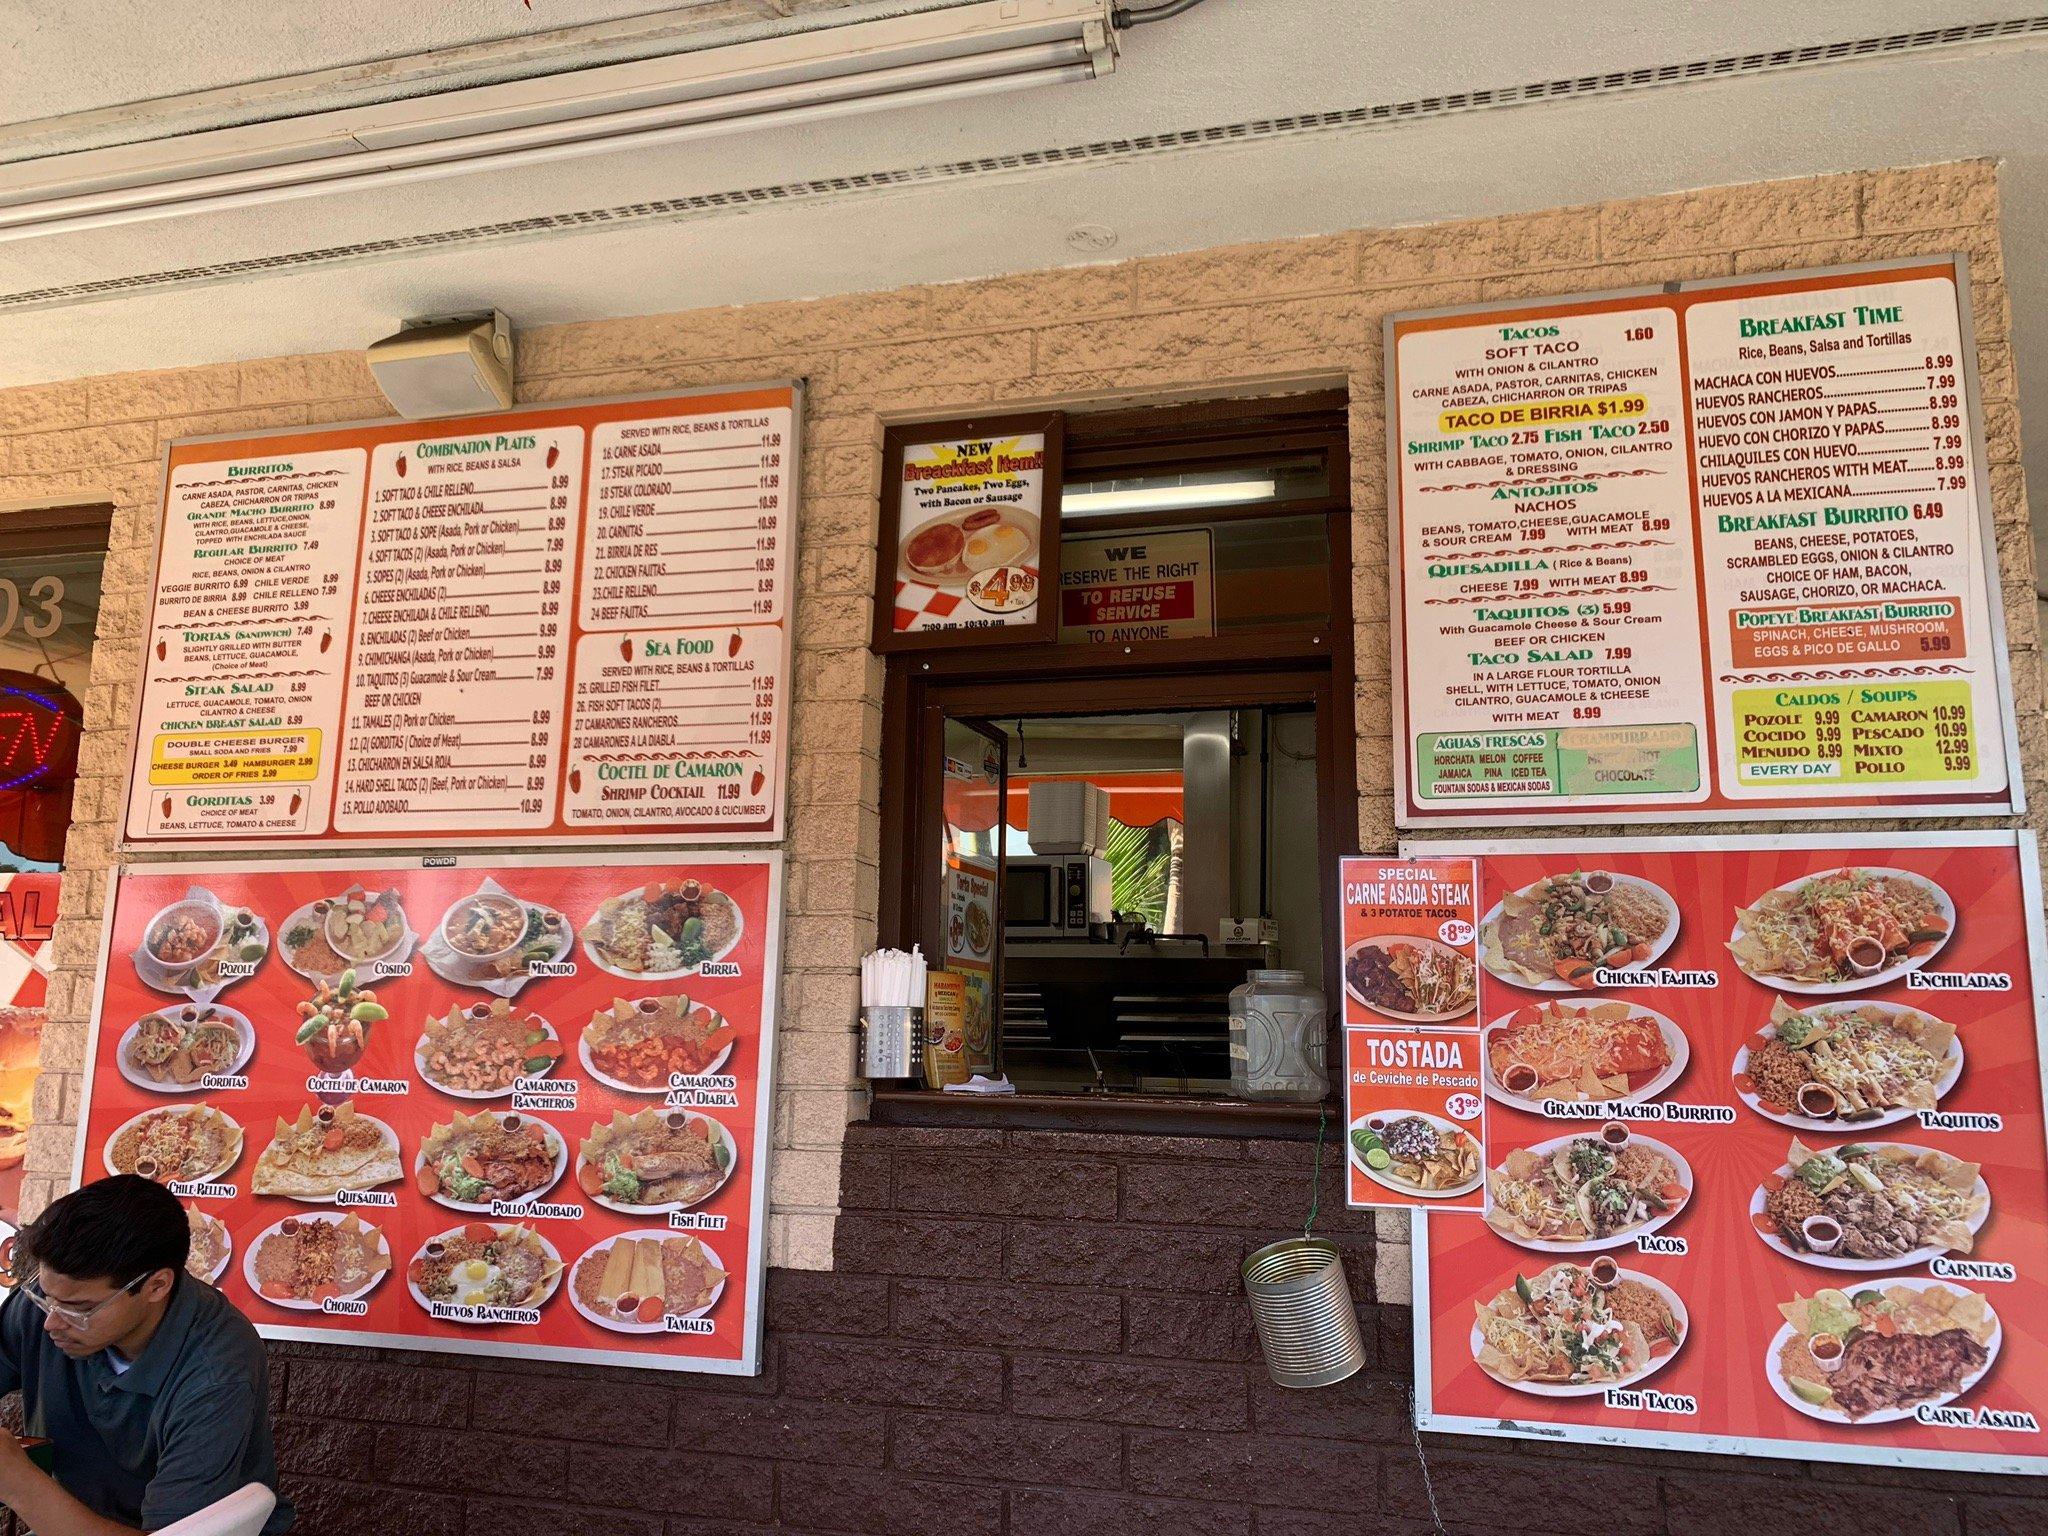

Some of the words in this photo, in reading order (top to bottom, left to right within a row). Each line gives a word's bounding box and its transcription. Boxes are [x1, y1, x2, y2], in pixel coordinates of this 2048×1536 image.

[1739, 311, 1846, 338] BREAKFAST
[1853, 306, 1903, 326] TIME
[1499, 326, 1559, 342] TACOS
[1624, 327, 1653, 342] 1.60
[1485, 346, 1527, 360] SOFT
[1534, 341, 1580, 355] TACO
[1695, 373, 1753, 391] MACHACA
[1756, 371, 1782, 385] CON
[1925, 355, 1953, 369] 8.99
[1696, 394, 1745, 410] HUEVOS
[1927, 374, 1955, 389] 7.99
[1445, 413, 1495, 429] TACO
[1500, 410, 1524, 423] DE
[1530, 405, 1593, 421] BIRRIA
[1598, 399, 1644, 415] $1.99
[1408, 439, 1465, 455] SHRIMP
[1470, 435, 1508, 449] TACO
[1511, 431, 1539, 445] 2.75
[1544, 429, 1582, 444] FISH
[1589, 424, 1636, 439] TACO
[1638, 420, 1670, 435] 2.50
[417, 440, 491, 459] COMBINATION
[495, 436, 535, 451] PLATES
[957, 442, 993, 457] NEW
[227, 463, 293, 476] BURRITOS
[904, 458, 993, 481] Breackfast
[914, 488, 934, 496] Two
[936, 483, 980, 493] Pancakes,
[983, 481, 1003, 489] Two
[1006, 479, 1029, 489] Eggs,
[1490, 482, 1598, 501] ANTOJITOS
[920, 498, 941, 508] with
[944, 498, 971, 506] Bacon
[986, 493, 1022, 503] Sausage
[1514, 500, 1576, 514] NACHOS
[1718, 511, 1817, 533] BREAKFAST
[1824, 505, 1909, 526] BURRITO
[1913, 502, 1943, 519] 6.49
[1104, 546, 1146, 561] WE
[1124, 568, 1150, 580] THE
[1157, 562, 1198, 578] RIGHT
[1428, 559, 1548, 578] QUESADILLA
[1081, 591, 1102, 604] TO
[1110, 586, 1176, 603] REFUSE
[1096, 604, 1160, 621] SERVICE
[1473, 606, 1569, 621] TAQUITOS
[1577, 603, 1599, 616] (3)
[1603, 602, 1631, 615] 5.99
[1738, 611, 1796, 627] POPEYE
[1800, 607, 1880, 624] BREAKFAST
[1885, 604, 1952, 619] BURRITO
[1087, 630, 1106, 644] TO
[1112, 626, 1169, 640] ANYONE
[646, 639, 671, 656] SEA
[677, 638, 713, 654] FOOD
[185, 685, 225, 696] STEAK
[231, 683, 273, 693] SALAD
[291, 682, 306, 692] 8.99
[1776, 692, 1840, 706] CALDOS
[1861, 689, 1917, 703] SOUPS
[1745, 714, 1802, 726] POZOLE
[1815, 710, 1840, 725] 9.99
[1851, 709, 1927, 722] CAMARON
[1933, 706, 1965, 720] 10.99
[1744, 730, 1805, 742] COCIDO
[1816, 727, 1841, 741] 9.99
[1852, 727, 1924, 740] PESCADO
[1934, 723, 1967, 737] 10.99
[1435, 736, 1481, 750] AGUAS
[1486, 734, 1545, 747] FRESCAS
[1854, 745, 1903, 756] MIXTO
[1936, 739, 1968, 754] 12.99
[1742, 747, 1810, 759] MENUDO
[1817, 744, 1842, 758] 8.99
[598, 763, 648, 780] COCTEL
[653, 763, 670, 778] DE
[675, 761, 743, 777] CAMARON
[1751, 765, 1798, 775] EVERY
[1803, 763, 1832, 774] DAY
[1855, 762, 1905, 774] POLLO
[1944, 757, 1970, 770] 9.99
[602, 786, 646, 800] SHRIMP
[651, 784, 705, 799] COCKTAIL
[187, 795, 252, 806] GORDITAS
[259, 795, 274, 805] 3.99
[423, 857, 456, 866] POWDR
[1379, 869, 1437, 880] SPECIAL
[1347, 883, 1385, 904] CARNE
[1389, 883, 1428, 905] ASADA
[1432, 884, 1470, 905] STEAK
[1361, 908, 1367, 917] &
[1371, 909, 1376, 917] 3
[1380, 909, 1422, 917] POTATOE
[1426, 909, 1457, 917] TACOS
[219, 963, 253, 974] POZOLE
[375, 964, 410, 974] COSIDO
[531, 963, 575, 974] MENUDO
[701, 963, 739, 974] BIRRIA
[1596, 970, 1656, 984] CHICKEN
[1662, 971, 1716, 984] FAJITAS
[1909, 973, 2009, 989] ENCHILADAS
[1367, 1039, 1463, 1068] TOSTADA
[203, 1076, 246, 1087] GORDITAS
[308, 1078, 342, 1090] COCTEL
[345, 1079, 356, 1090] DE
[360, 1080, 407, 1092] CAMARON
[514, 1080, 575, 1092] CAMARONES
[671, 1075, 734, 1088] CAMARONES
[1354, 1071, 1366, 1082] de
[1370, 1071, 1412, 1084] Ceviche
[1416, 1074, 1428, 1085] de
[1433, 1073, 1478, 1086] Pescado
[513, 1097, 574, 1108] RANCHEROS
[667, 1093, 674, 1104] A
[676, 1093, 694, 1104] LA
[696, 1093, 736, 1104] DIABLA
[1544, 1101, 1602, 1117] GRANDE
[1609, 1103, 1660, 1118] MACHO
[1667, 1104, 1733, 1121] BURRITO
[1920, 1112, 1999, 1128] TAQUITOS
[169, 1182, 196, 1194] CHILE
[197, 1184, 235, 1196] RELLENO
[337, 1191, 395, 1205] QUESADILLA
[493, 1202, 525, 1215] POLLO
[529, 1203, 582, 1218] ADOBADO
[671, 1214, 694, 1227] FISH
[698, 1216, 724, 1228] FILET
[1638, 1235, 1686, 1253] TACOS
[1932, 1260, 2013, 1279] CARNITAS
[324, 1300, 366, 1313] CHORIZO
[432, 1304, 473, 1318] HUEVOS
[477, 1307, 538, 1322] RANCHEROS
[666, 1317, 713, 1332] TAMALES
[1607, 1390, 1642, 1409] FISH
[1646, 1392, 1695, 1412] TACOS
[1917, 1406, 1973, 1427] CARNE
[1978, 1410, 2036, 1430] ASADA
